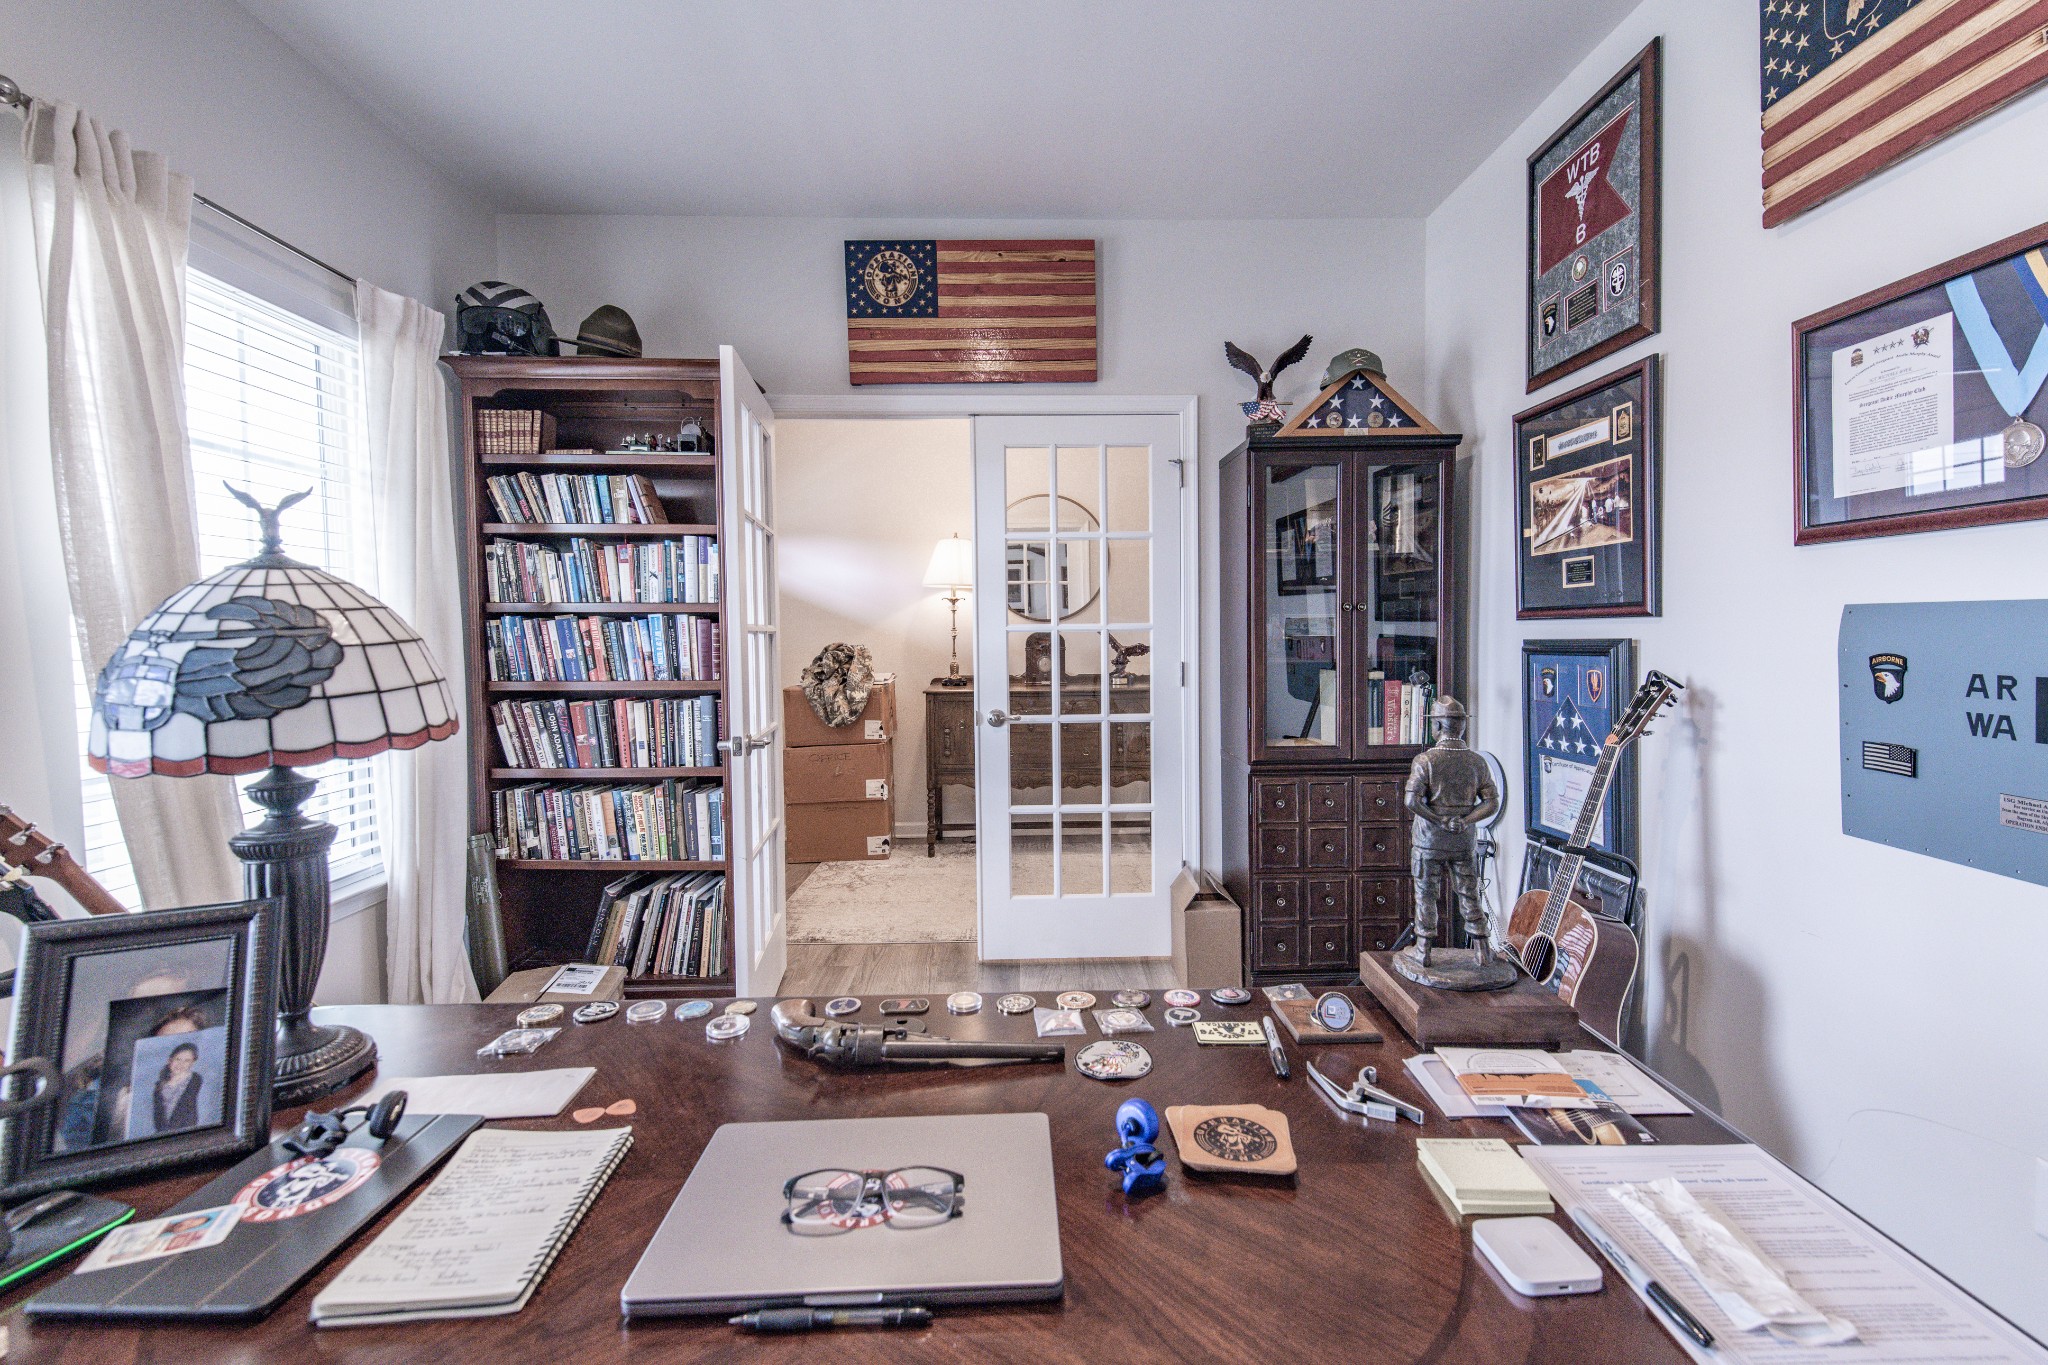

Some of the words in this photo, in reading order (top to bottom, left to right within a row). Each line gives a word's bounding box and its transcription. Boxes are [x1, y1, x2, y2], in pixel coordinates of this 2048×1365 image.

[1566, 142, 1600, 184] WTB
[1576, 223, 1586, 245] B
[867, 252, 917, 278] OPERATION
[875, 293, 911, 305] SONG
[1871, 656, 1904, 666] AIRBORNE
[1966, 674, 2018, 702] AR
[559, 716, 571, 733] 1776
[1387, 699, 1397, 741] Webster's
[1966, 711, 2018, 742] WA
[548, 711, 559, 732] JOHN
[554, 733, 564, 760] ADAMS
[2017, 800, 2042, 809] Michael
[2005, 819, 2034, 829] OPERATION
[593, 908, 606, 946] LINCOLN
